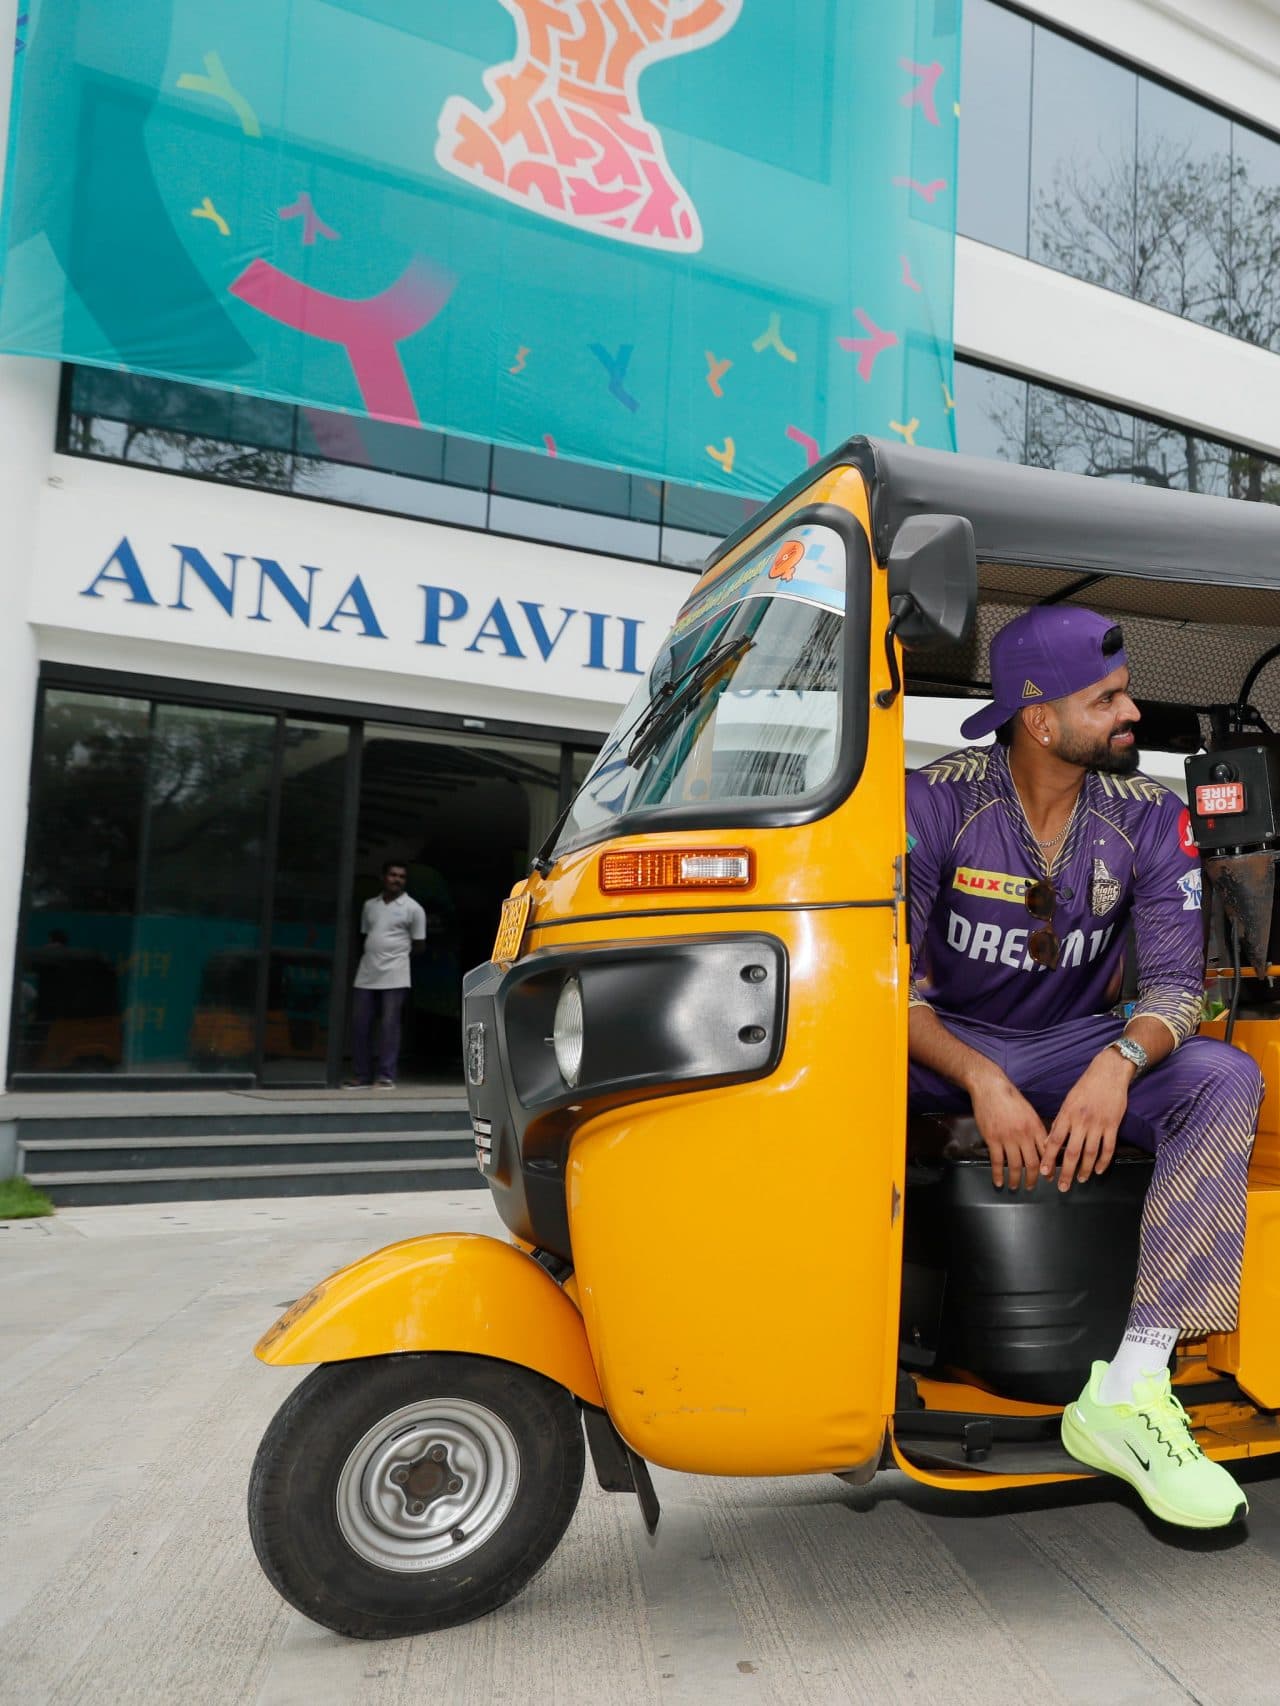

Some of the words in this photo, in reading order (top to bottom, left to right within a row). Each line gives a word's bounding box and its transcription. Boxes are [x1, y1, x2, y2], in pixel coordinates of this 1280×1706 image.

[79, 536, 387, 640] ANNA
[417, 584, 645, 677] PAVIL
[1202, 786, 1237, 799] HIRE
[1204, 797, 1237, 811] FOR
[947, 908, 1115, 972] DREM11
[1125, 1333, 1169, 1350] RIDERS
